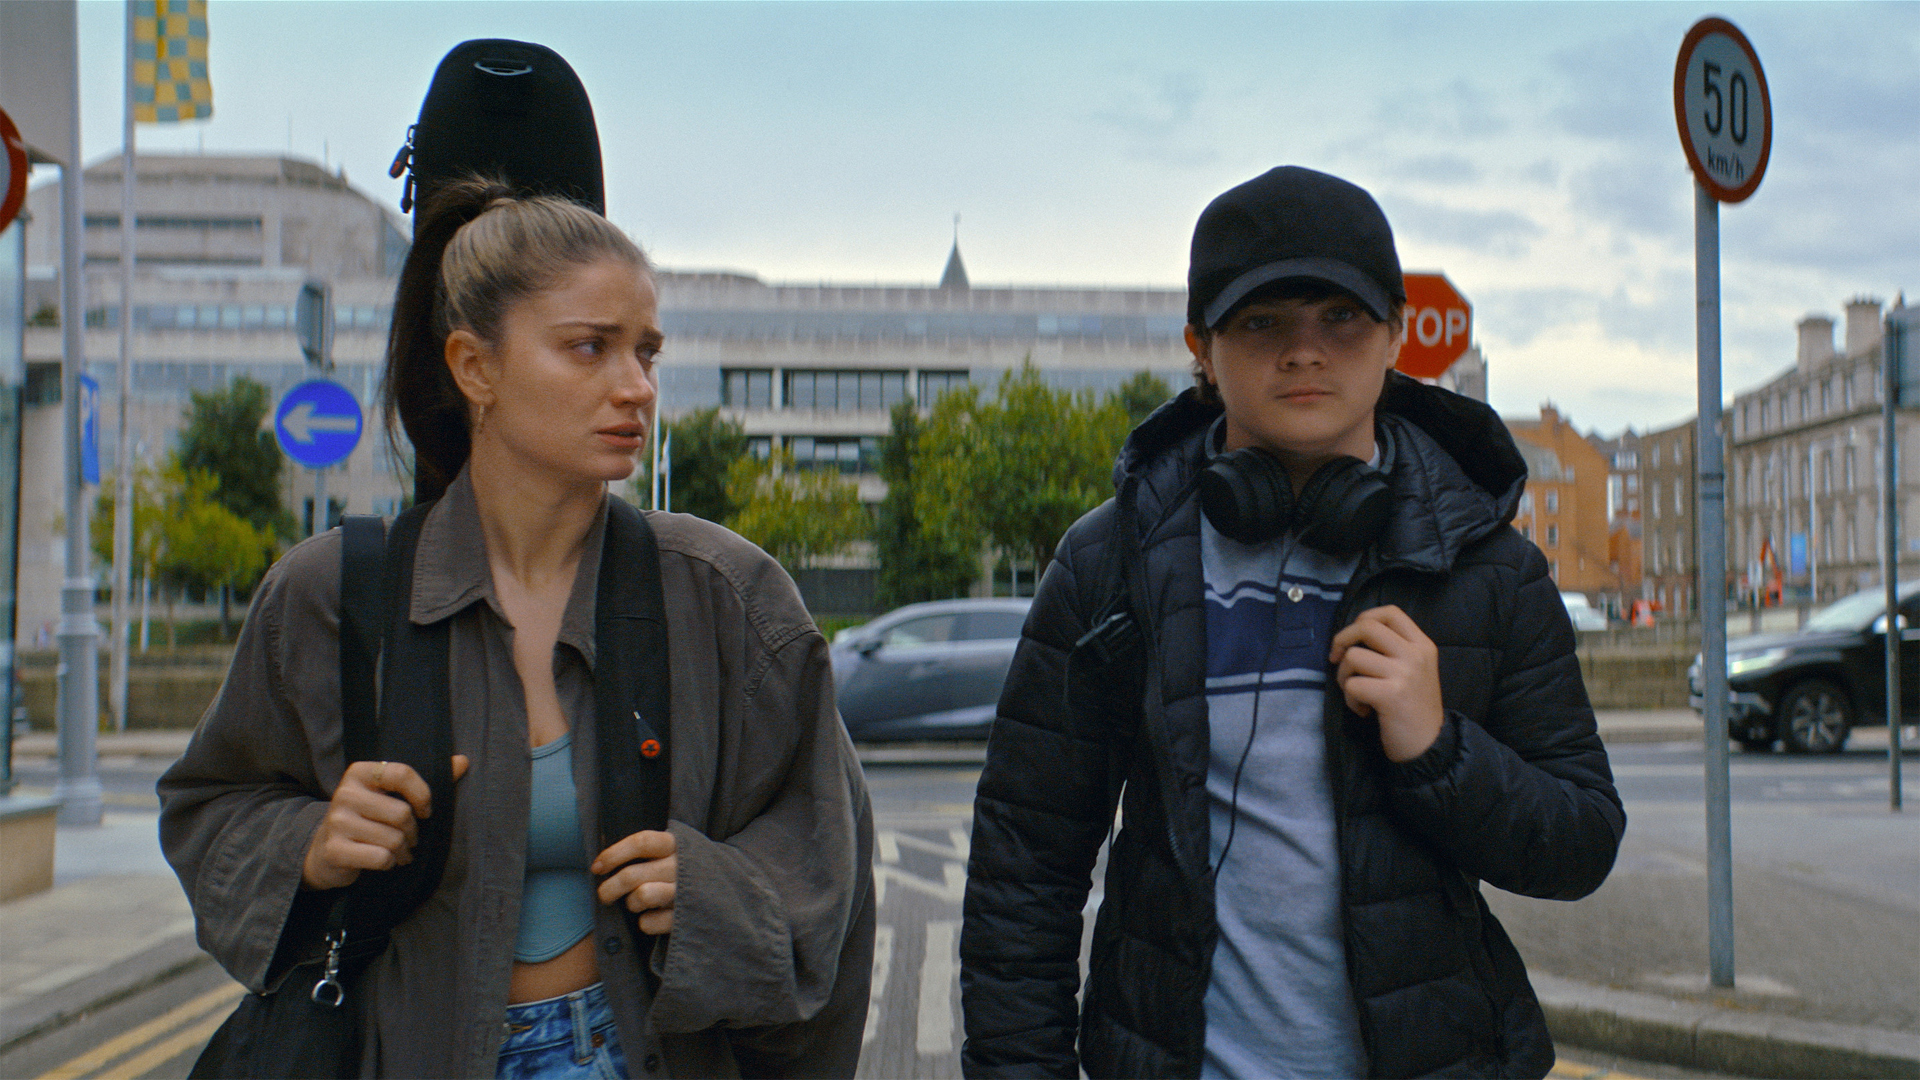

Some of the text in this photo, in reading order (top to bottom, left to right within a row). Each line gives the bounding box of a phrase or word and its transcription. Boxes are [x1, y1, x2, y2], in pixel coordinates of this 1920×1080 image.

[1704, 62, 1747, 144] 50
[1707, 147, 1744, 179] km/h
[1402, 305, 1467, 347] TOP
